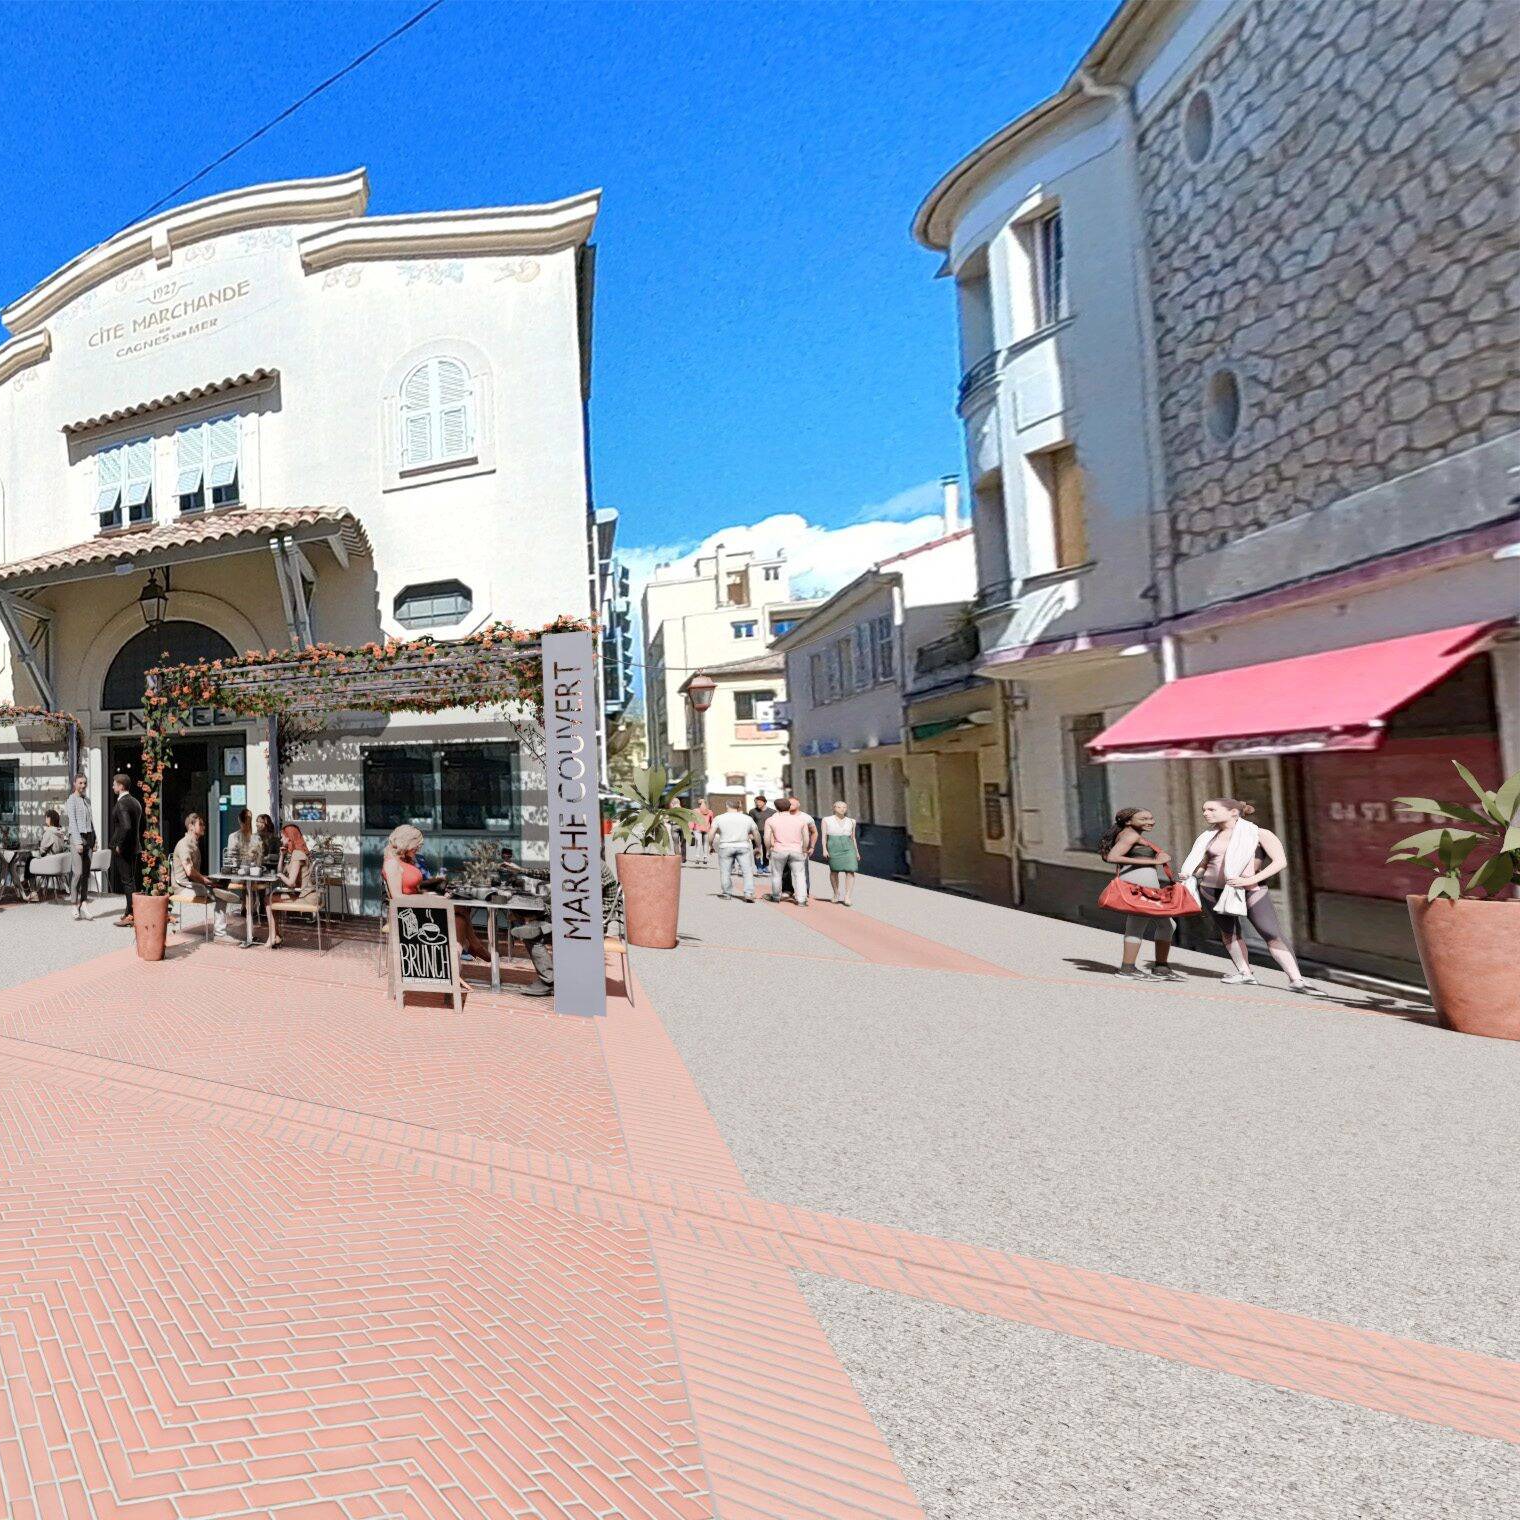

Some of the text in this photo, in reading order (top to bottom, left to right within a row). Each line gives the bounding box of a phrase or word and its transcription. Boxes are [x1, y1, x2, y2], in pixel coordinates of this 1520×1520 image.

[132, 279, 251, 334] MARCHANDE
[153, 281, 177, 300] 1927
[115, 332, 170, 358] CAGNES
[188, 317, 218, 335] MER
[109, 706, 235, 732] ENEE
[553, 661, 592, 941] MARCHE COUVERT
[399, 942, 452, 979] BRUNCH
